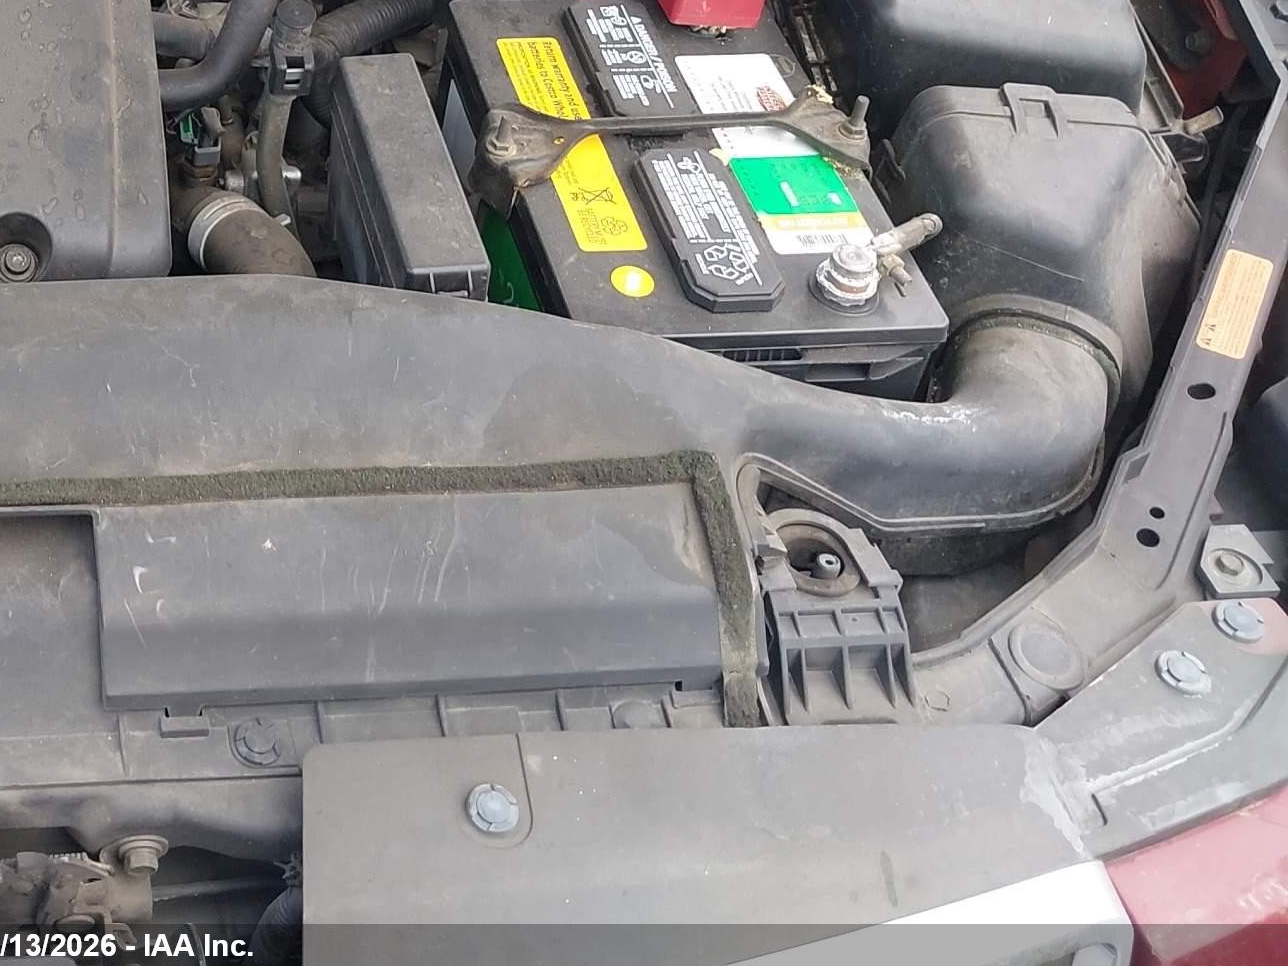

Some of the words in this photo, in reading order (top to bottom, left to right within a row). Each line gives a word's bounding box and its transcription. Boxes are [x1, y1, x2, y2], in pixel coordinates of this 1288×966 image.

[527, 41, 545, 69] batteries
[543, 78, 558, 98] Costco
[552, 64, 570, 92] warranty
[564, 93, 580, 106] and
[635, 24, 658, 56] DANGER
[653, 62, 678, 92] POISON
